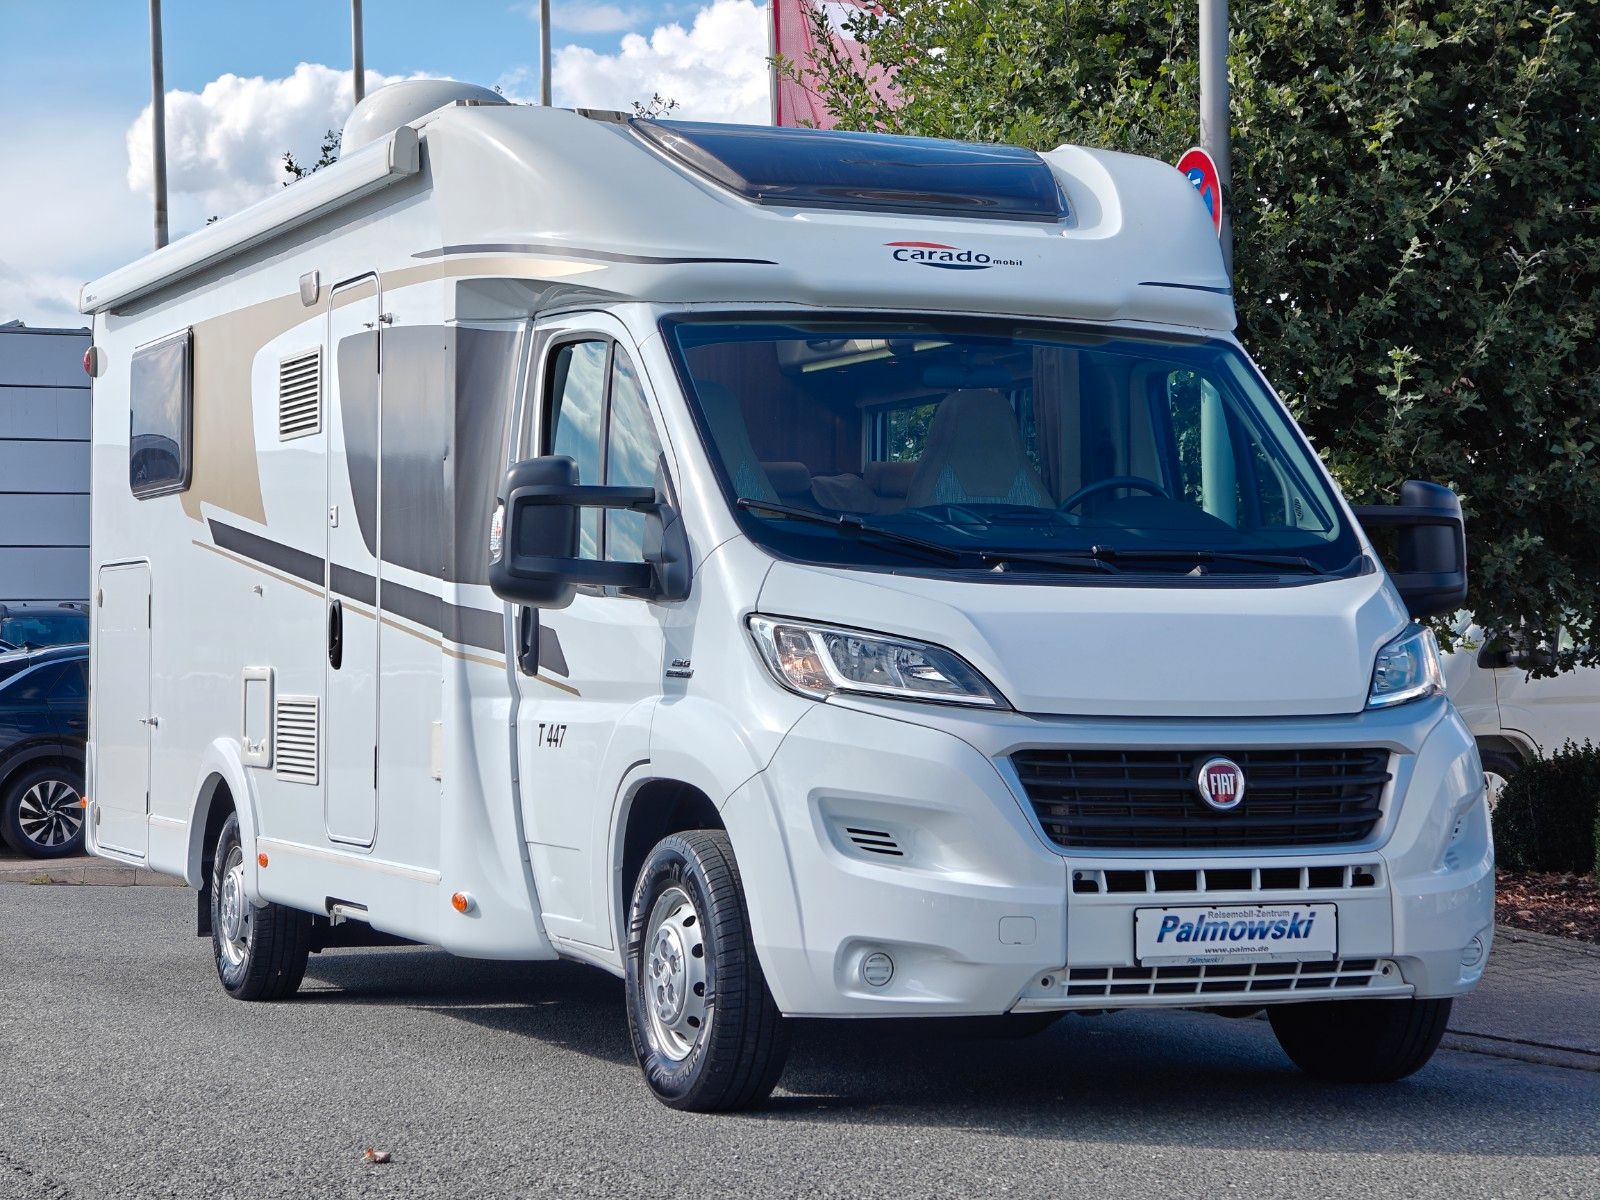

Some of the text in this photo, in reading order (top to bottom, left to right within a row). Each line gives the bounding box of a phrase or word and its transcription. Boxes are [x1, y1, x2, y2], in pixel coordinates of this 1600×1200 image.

[993, 258, 1023, 266] mobil
[538, 723, 567, 748] T 447
[1209, 773, 1235, 795] FIAT
[1207, 910, 1290, 919] Reisemobil-Zentrum
[1156, 911, 1317, 943] Palmowski
[1204, 945, 1269, 954] www.palmo.de
